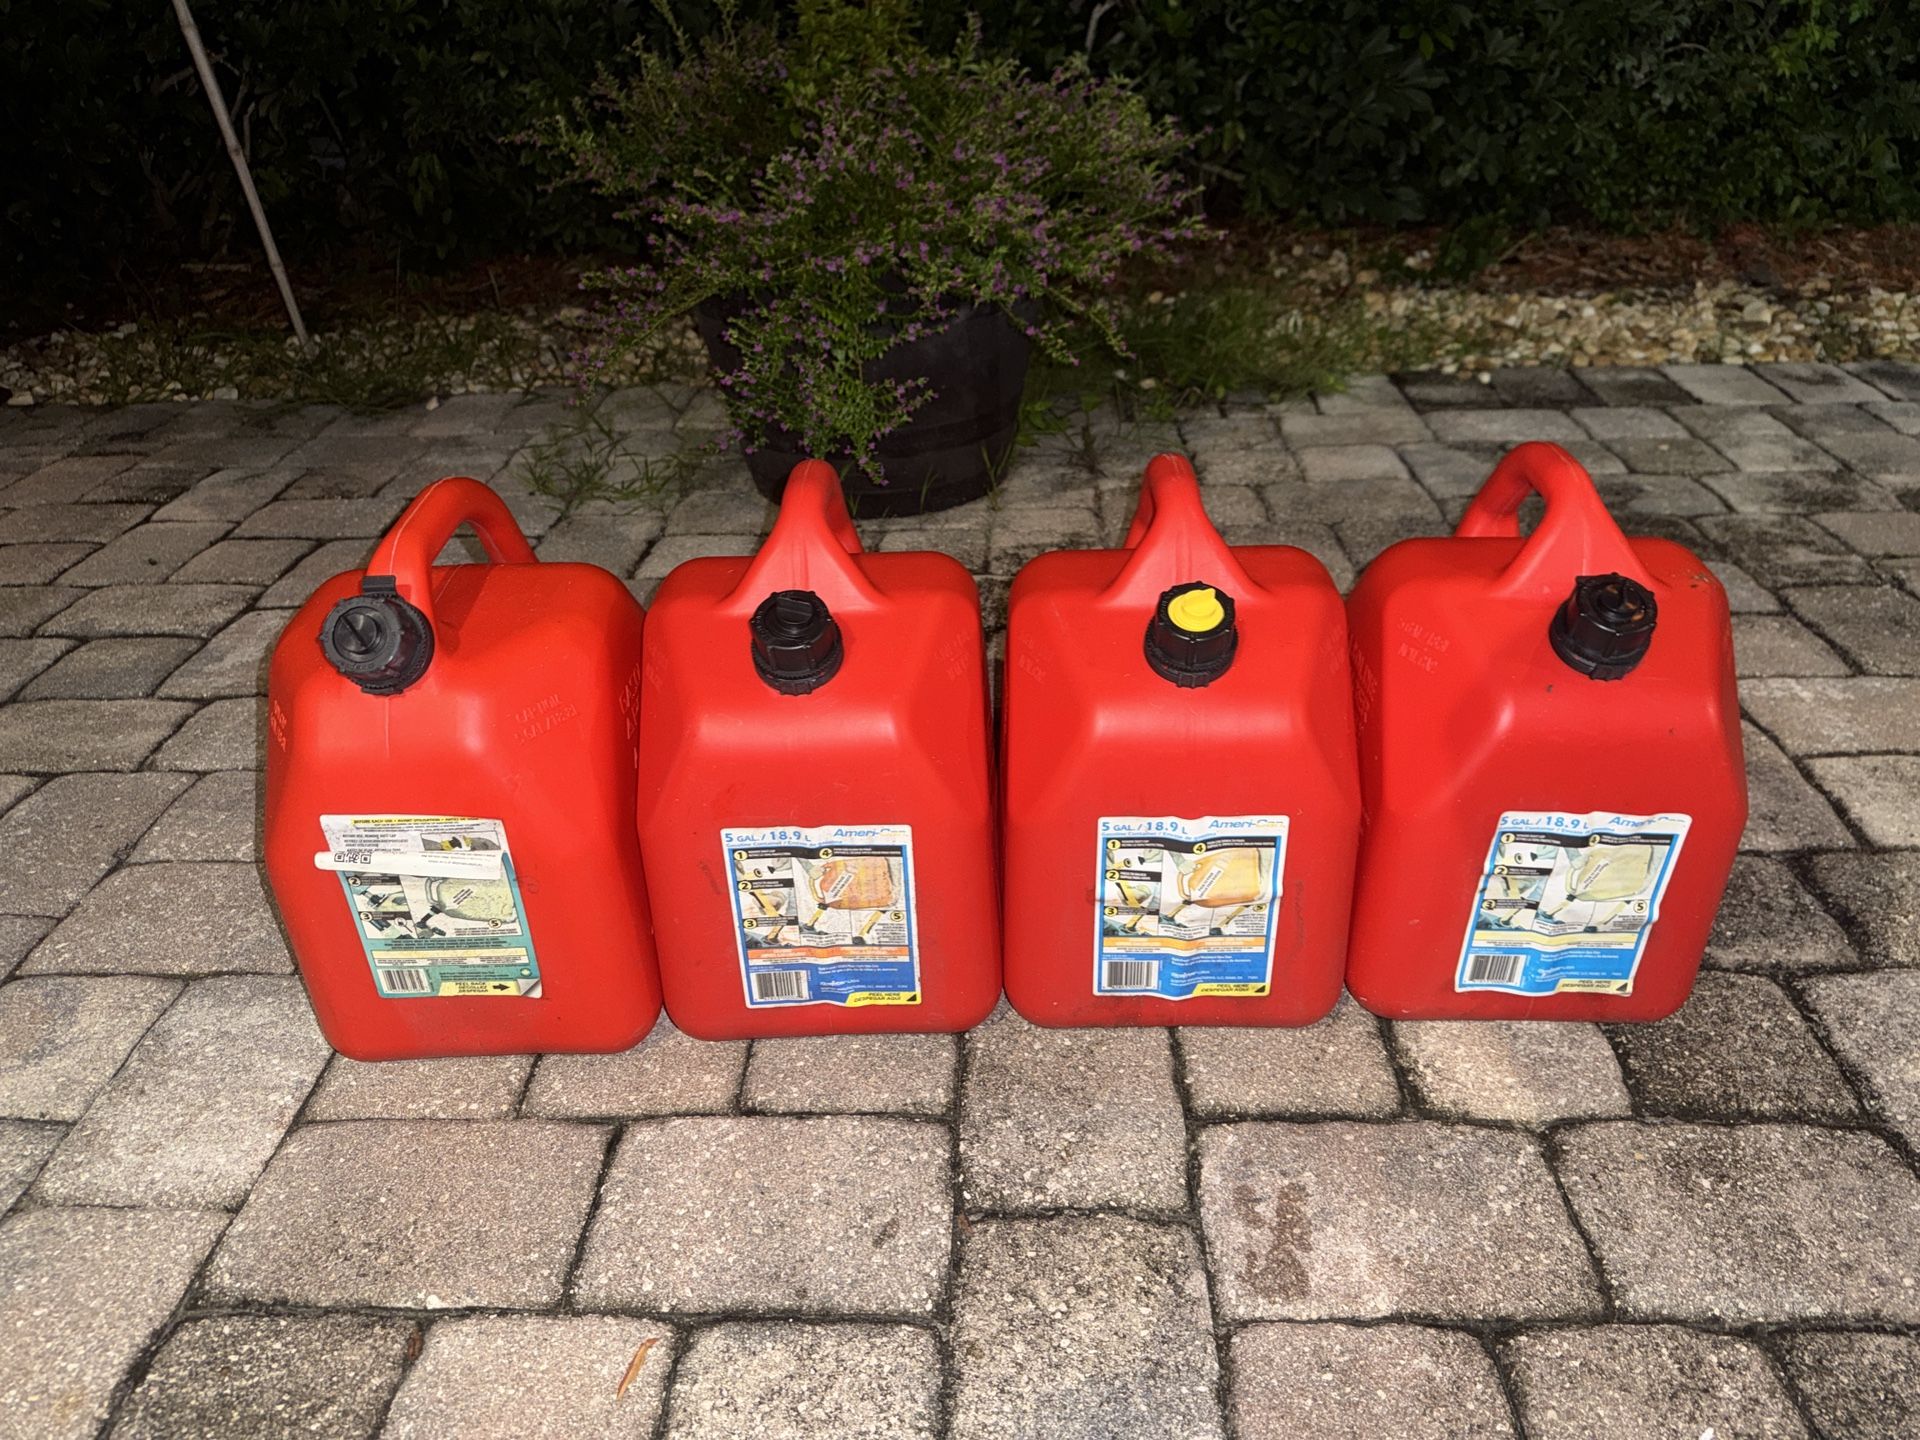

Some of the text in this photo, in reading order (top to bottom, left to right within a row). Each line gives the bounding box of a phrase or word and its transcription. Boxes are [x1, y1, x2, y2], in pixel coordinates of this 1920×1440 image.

[1102, 822, 1110, 831] 5
[1146, 822, 1179, 831] 18.9
[1182, 826, 1188, 834] L
[1500, 816, 1509, 825] 5
[1546, 816, 1580, 828] 18.9
[1583, 821, 1589, 829] L
[725, 833, 733, 842] 5
[770, 831, 801, 840] 18.9
